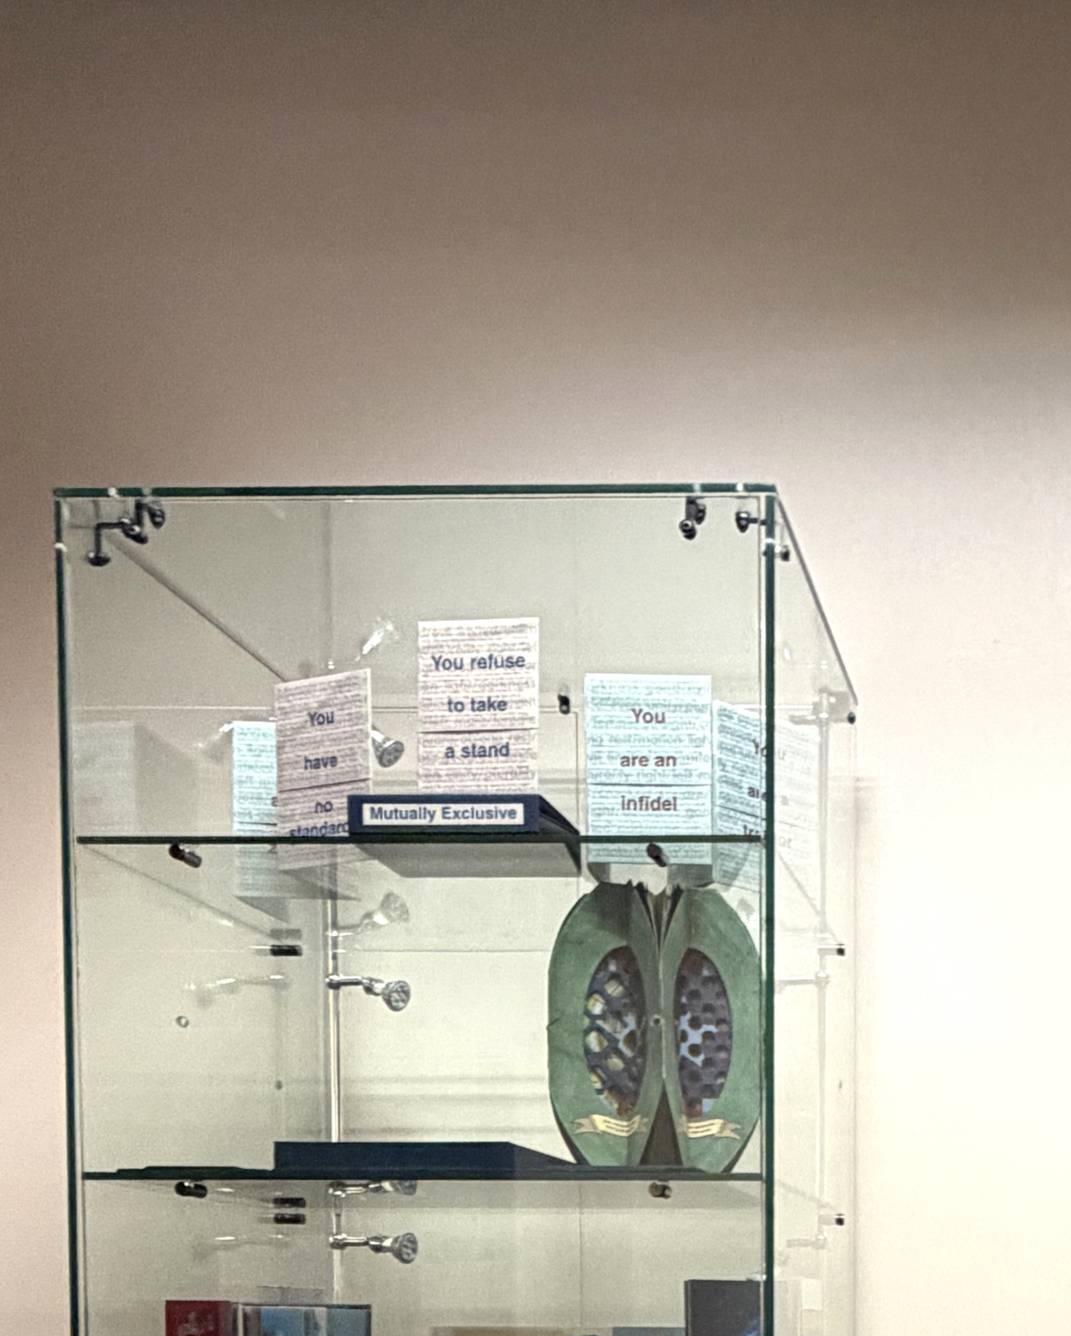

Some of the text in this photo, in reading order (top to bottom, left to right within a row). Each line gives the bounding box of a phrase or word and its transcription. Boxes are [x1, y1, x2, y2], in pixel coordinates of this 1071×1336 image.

[432, 654, 526, 671] You refuse
[447, 697, 508, 713] to take
[307, 711, 335, 726] You
[631, 708, 666, 724] You
[444, 742, 510, 759] a stand
[304, 753, 338, 771] have
[620, 755, 677, 768] are an
[315, 800, 333, 814] no
[620, 796, 678, 812] infidel
[369, 806, 518, 824] Mutually Exclusive
